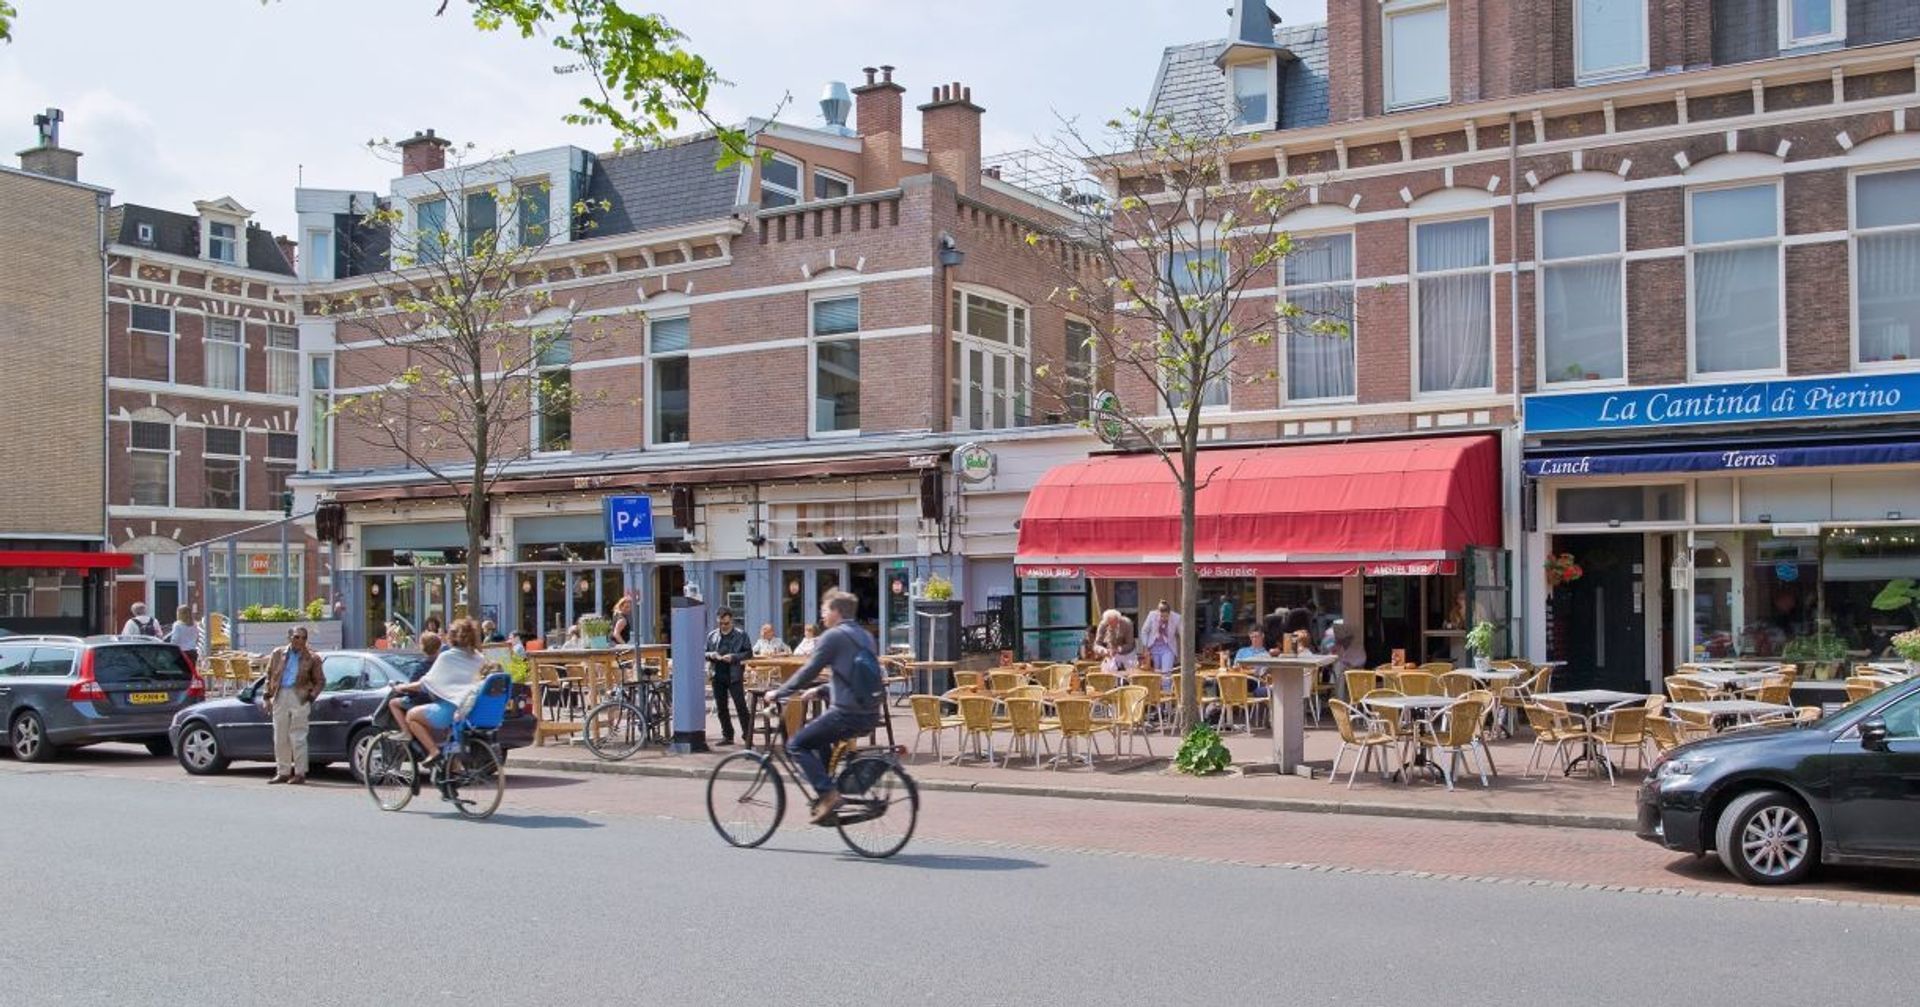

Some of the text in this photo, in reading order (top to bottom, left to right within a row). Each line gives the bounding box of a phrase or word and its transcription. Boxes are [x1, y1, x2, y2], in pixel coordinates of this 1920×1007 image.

[1597, 383, 1901, 422] La Cantina di Pierino
[1539, 456, 1590, 474] Lunch
[1722, 450, 1777, 467] Terras
[616, 511, 630, 532] P
[1373, 564, 1428, 575] AMSTEL BIER
